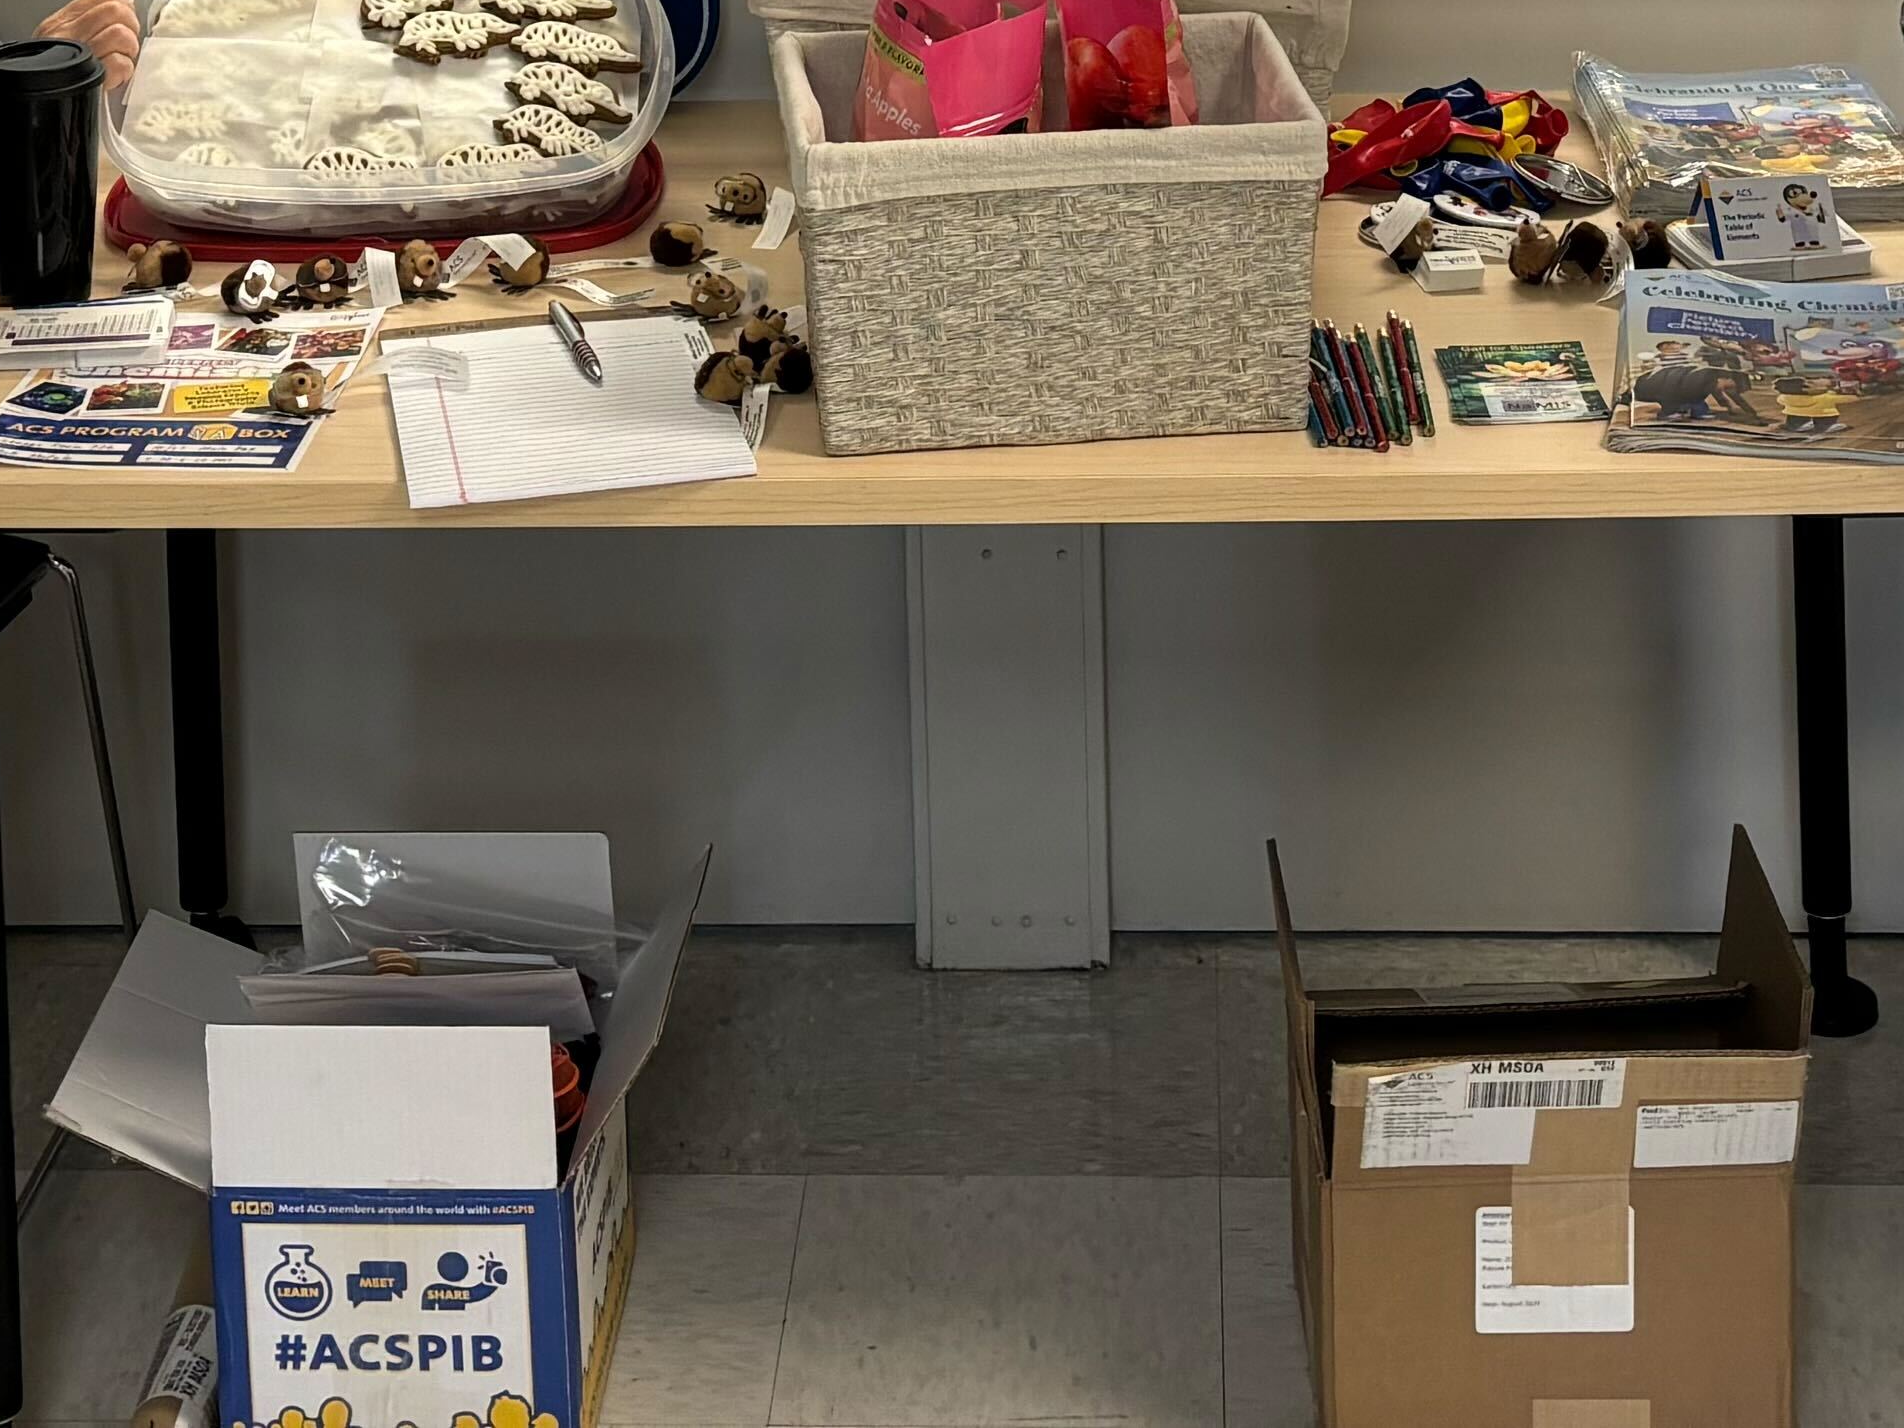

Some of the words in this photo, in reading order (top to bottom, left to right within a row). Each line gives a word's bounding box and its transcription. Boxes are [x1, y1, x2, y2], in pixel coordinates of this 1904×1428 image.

[1642, 284, 1793, 313] Celebrating
[6, 422, 56, 434] ACS
[59, 425, 184, 438] PROGRAM
[237, 428, 293, 439] BOX
[1469, 1062, 1492, 1074] XH
[278, 1204, 305, 1213] Meet
[307, 1205, 327, 1213] ACS
[328, 1205, 376, 1214] members
[377, 1205, 414, 1214] around
[415, 1205, 434, 1214] the
[435, 1205, 465, 1214] world
[467, 1205, 491, 1214] with
[359, 1277, 396, 1288] MEET
[276, 1287, 320, 1298] LEARN
[426, 1289, 471, 1300] SHARE
[274, 1333, 505, 1373] #ACSPIB
